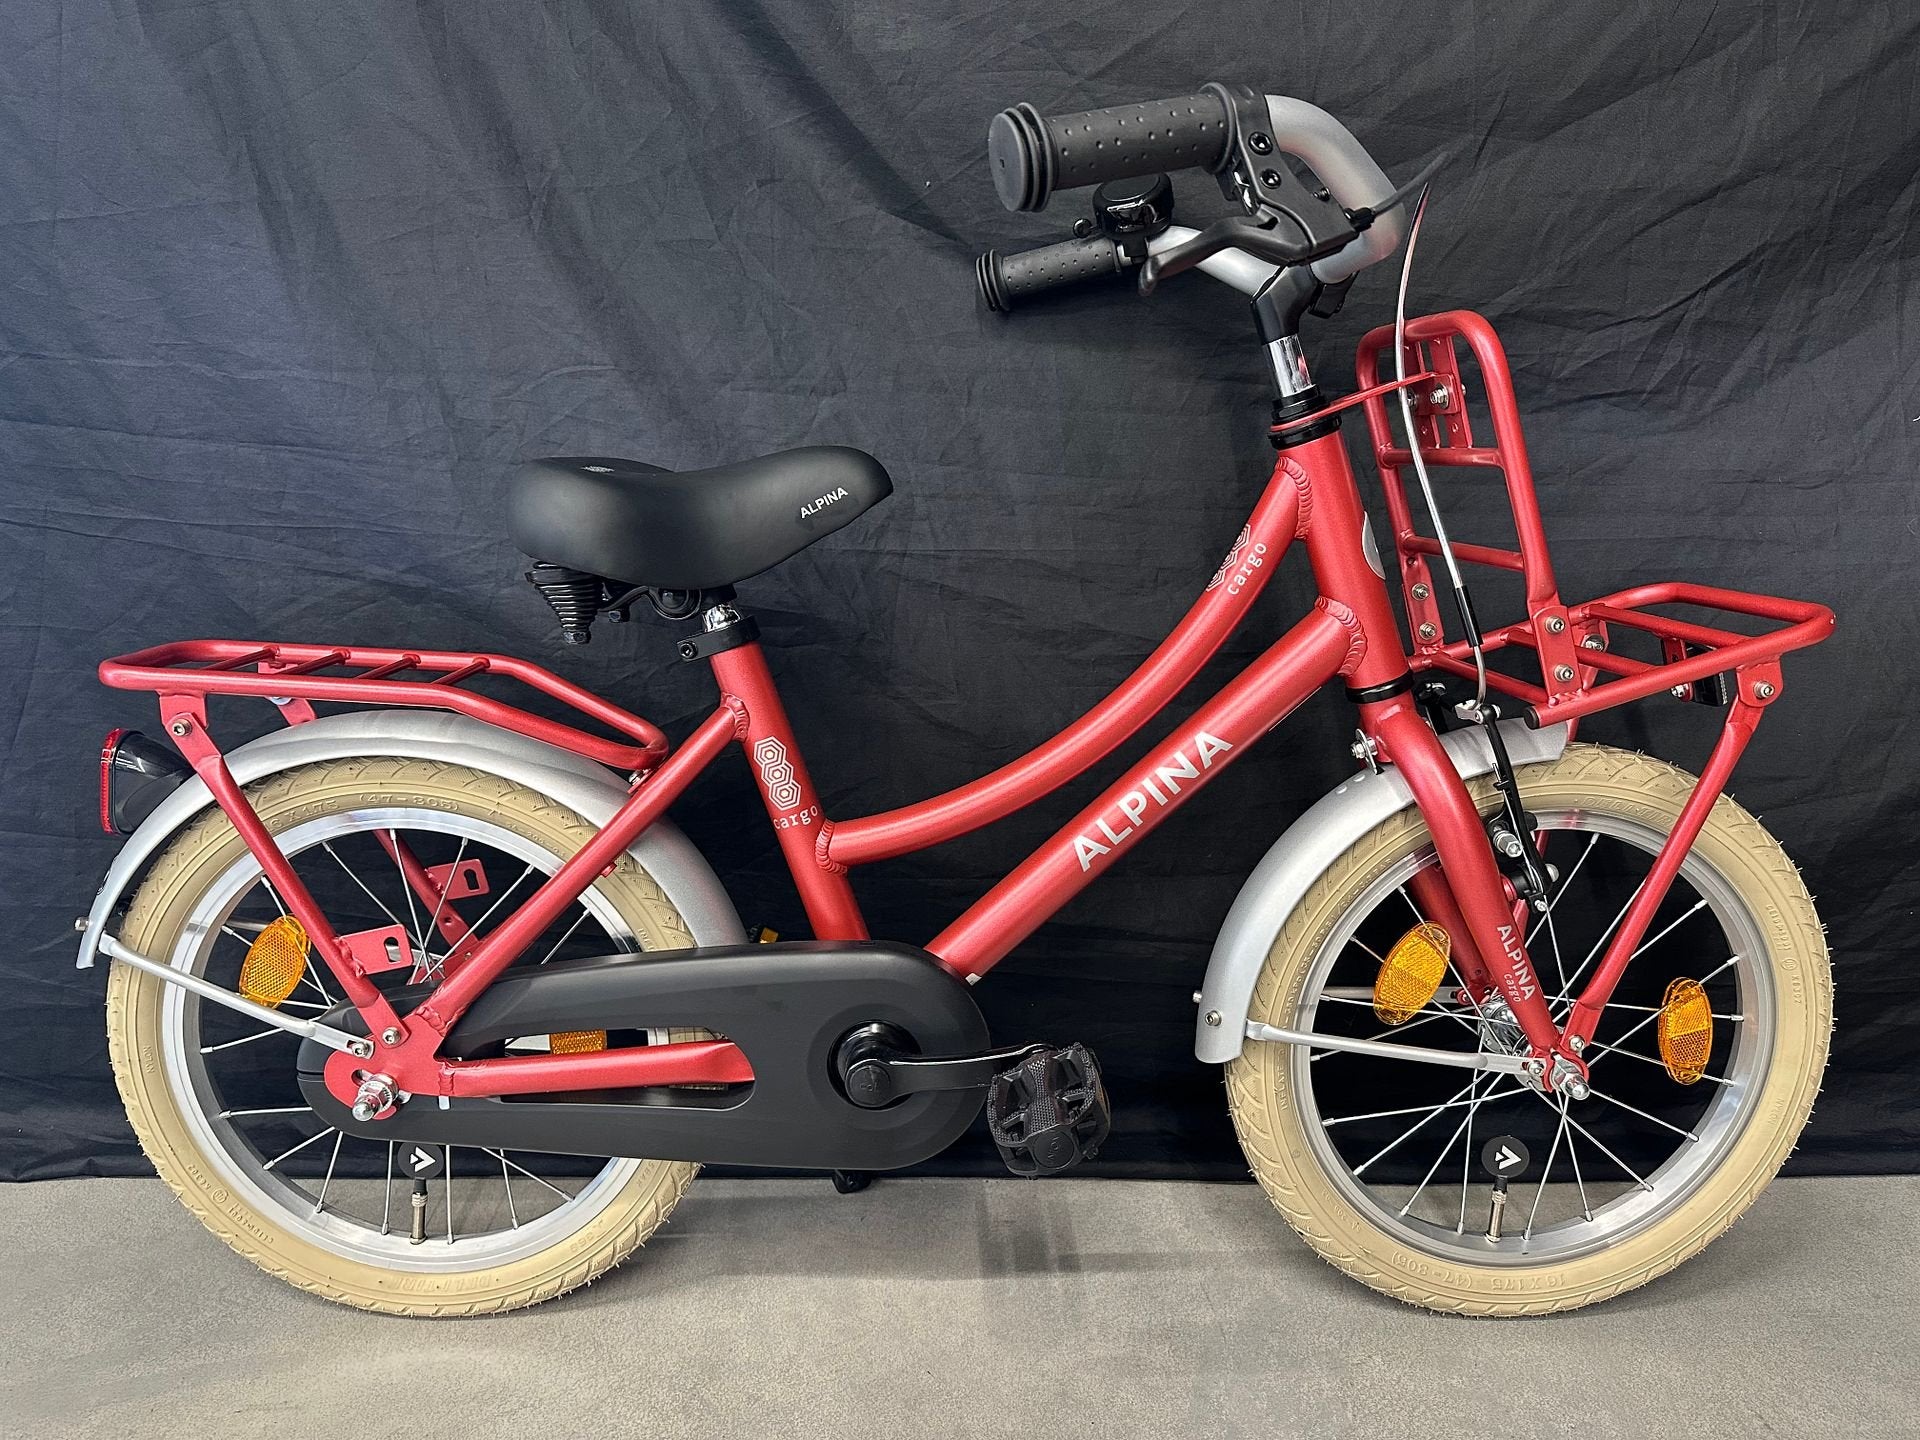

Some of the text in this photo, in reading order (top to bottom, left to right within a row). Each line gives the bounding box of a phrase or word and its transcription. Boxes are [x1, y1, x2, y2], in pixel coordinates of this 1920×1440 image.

[801, 487, 848, 519] ALPINA
[1227, 542, 1267, 595] cargo
[773, 805, 818, 830] cargo
[1073, 731, 1233, 872] ALPINA
[1497, 925, 1535, 1000] ALPINA
[1504, 973, 1521, 1002] cargo
